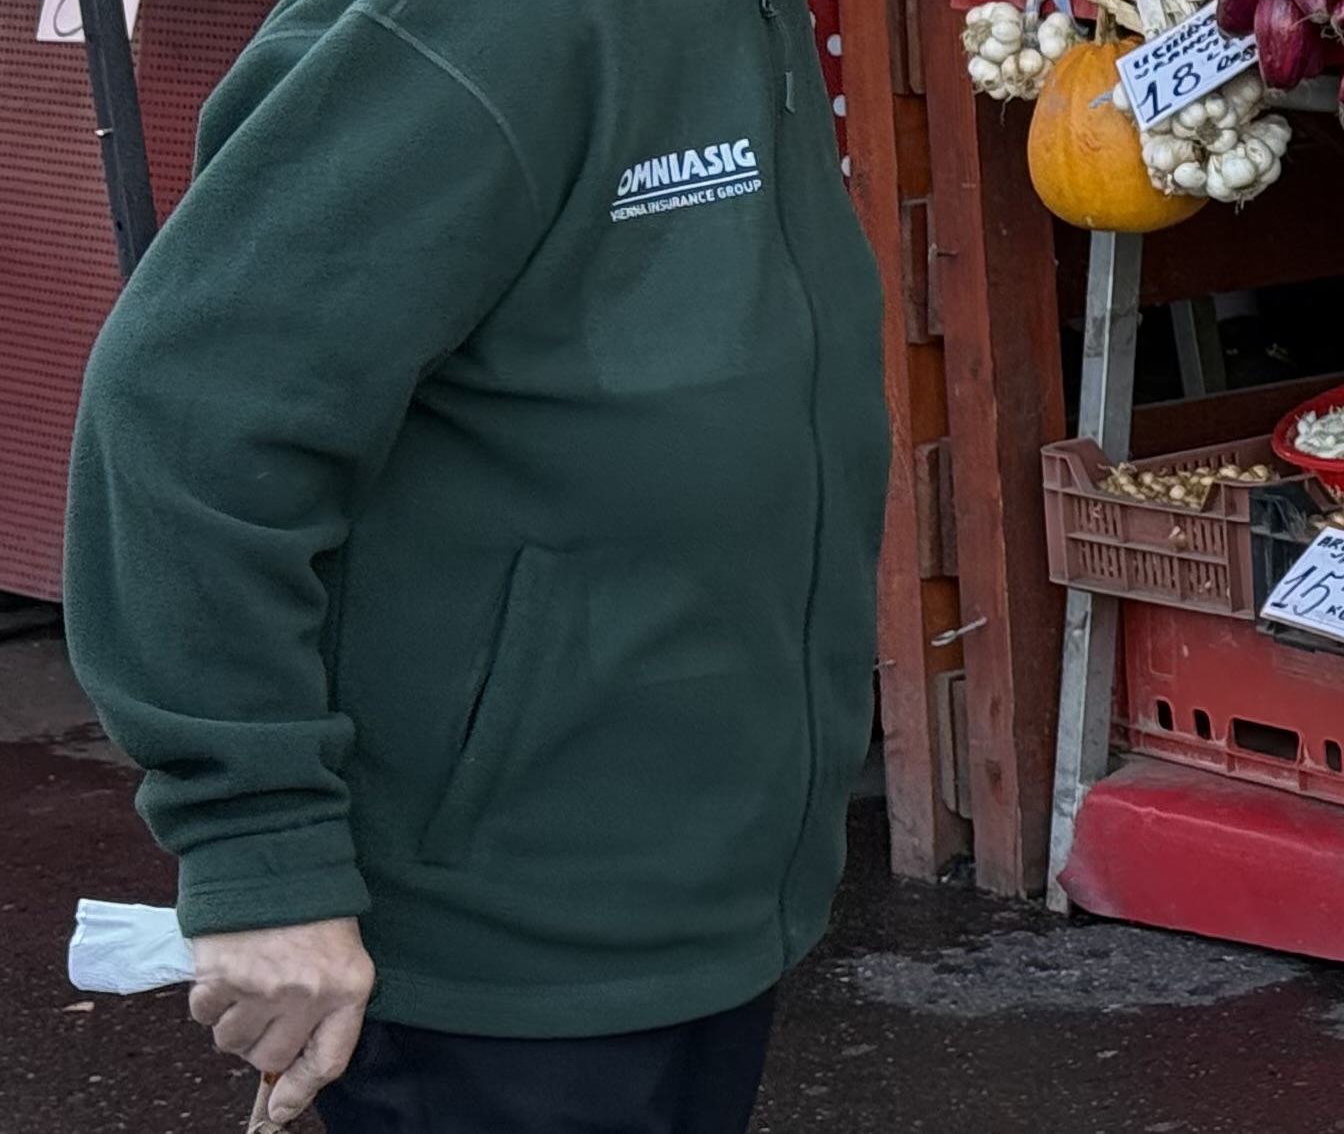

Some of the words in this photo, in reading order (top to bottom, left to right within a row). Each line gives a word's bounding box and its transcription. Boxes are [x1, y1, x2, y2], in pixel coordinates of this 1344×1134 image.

[1136, 62, 1201, 123] 18
[617, 138, 757, 196] OMNIASIG
[648, 188, 716, 215] INSURANCE
[716, 179, 762, 200] GROUP
